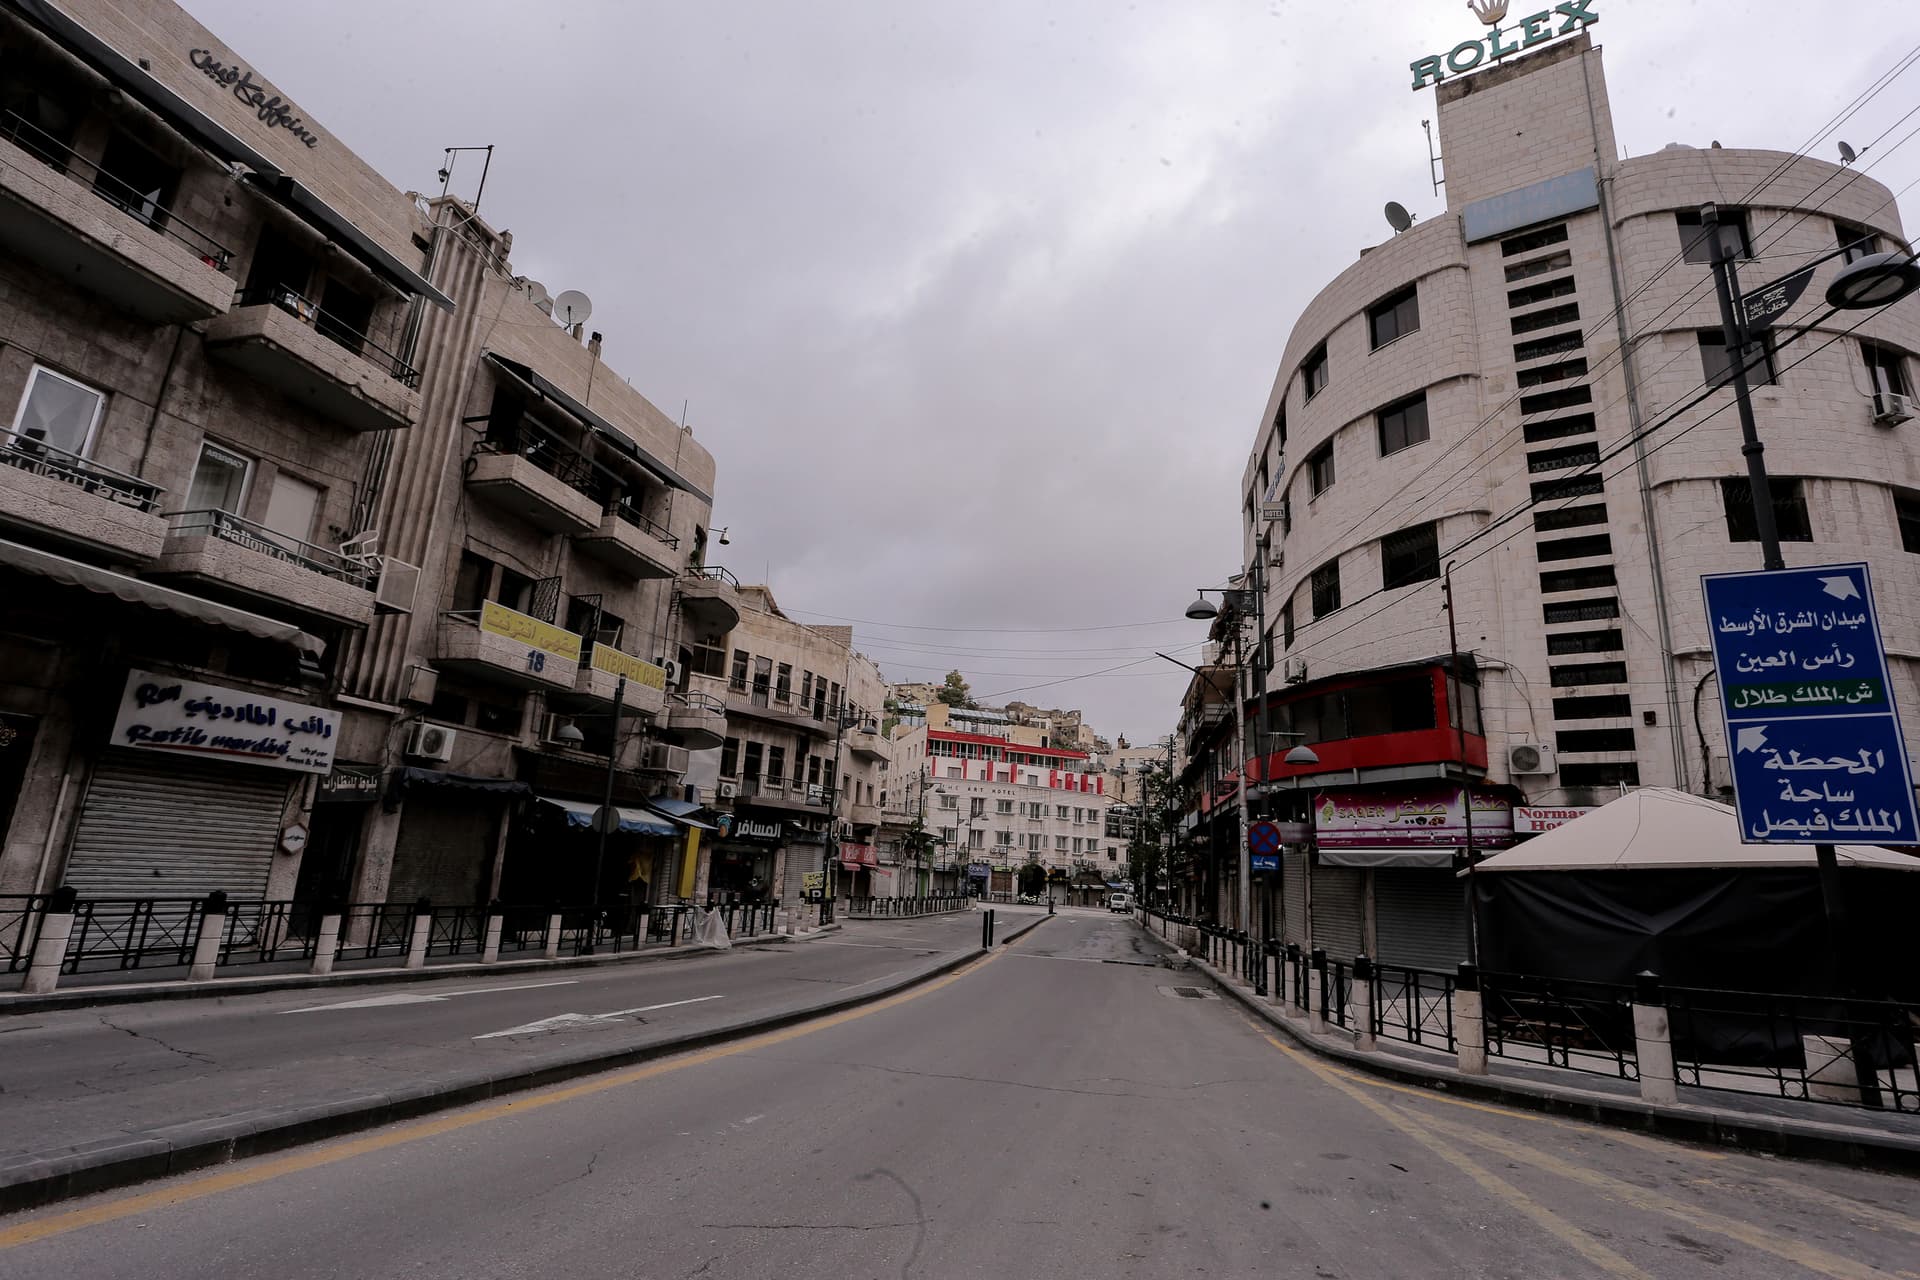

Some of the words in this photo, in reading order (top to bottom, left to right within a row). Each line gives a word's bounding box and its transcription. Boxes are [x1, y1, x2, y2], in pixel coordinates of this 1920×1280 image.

[1410, 0, 1599, 91] ROLEX
[234, 72, 318, 149] Kaffeine
[1719, 608, 1771, 636] الأوسط
[1775, 611, 1818, 634] الشرق
[1822, 611, 1866, 631] ميدان
[528, 650, 545, 672] 18
[1736, 650, 1796, 672] العين
[1802, 642, 1855, 670] رأس
[1734, 688, 1788, 708] طلال
[184, 696, 276, 726] المارديني
[127, 725, 207, 744] Ratib
[1760, 749, 1885, 775] المحطة
[1777, 778, 1855, 803] ساحة
[1339, 806, 1385, 818] SAQER
[1752, 807, 1829, 838] فيصل
[1831, 808, 1902, 835] الملك
[735, 819, 781, 838] المسافر
